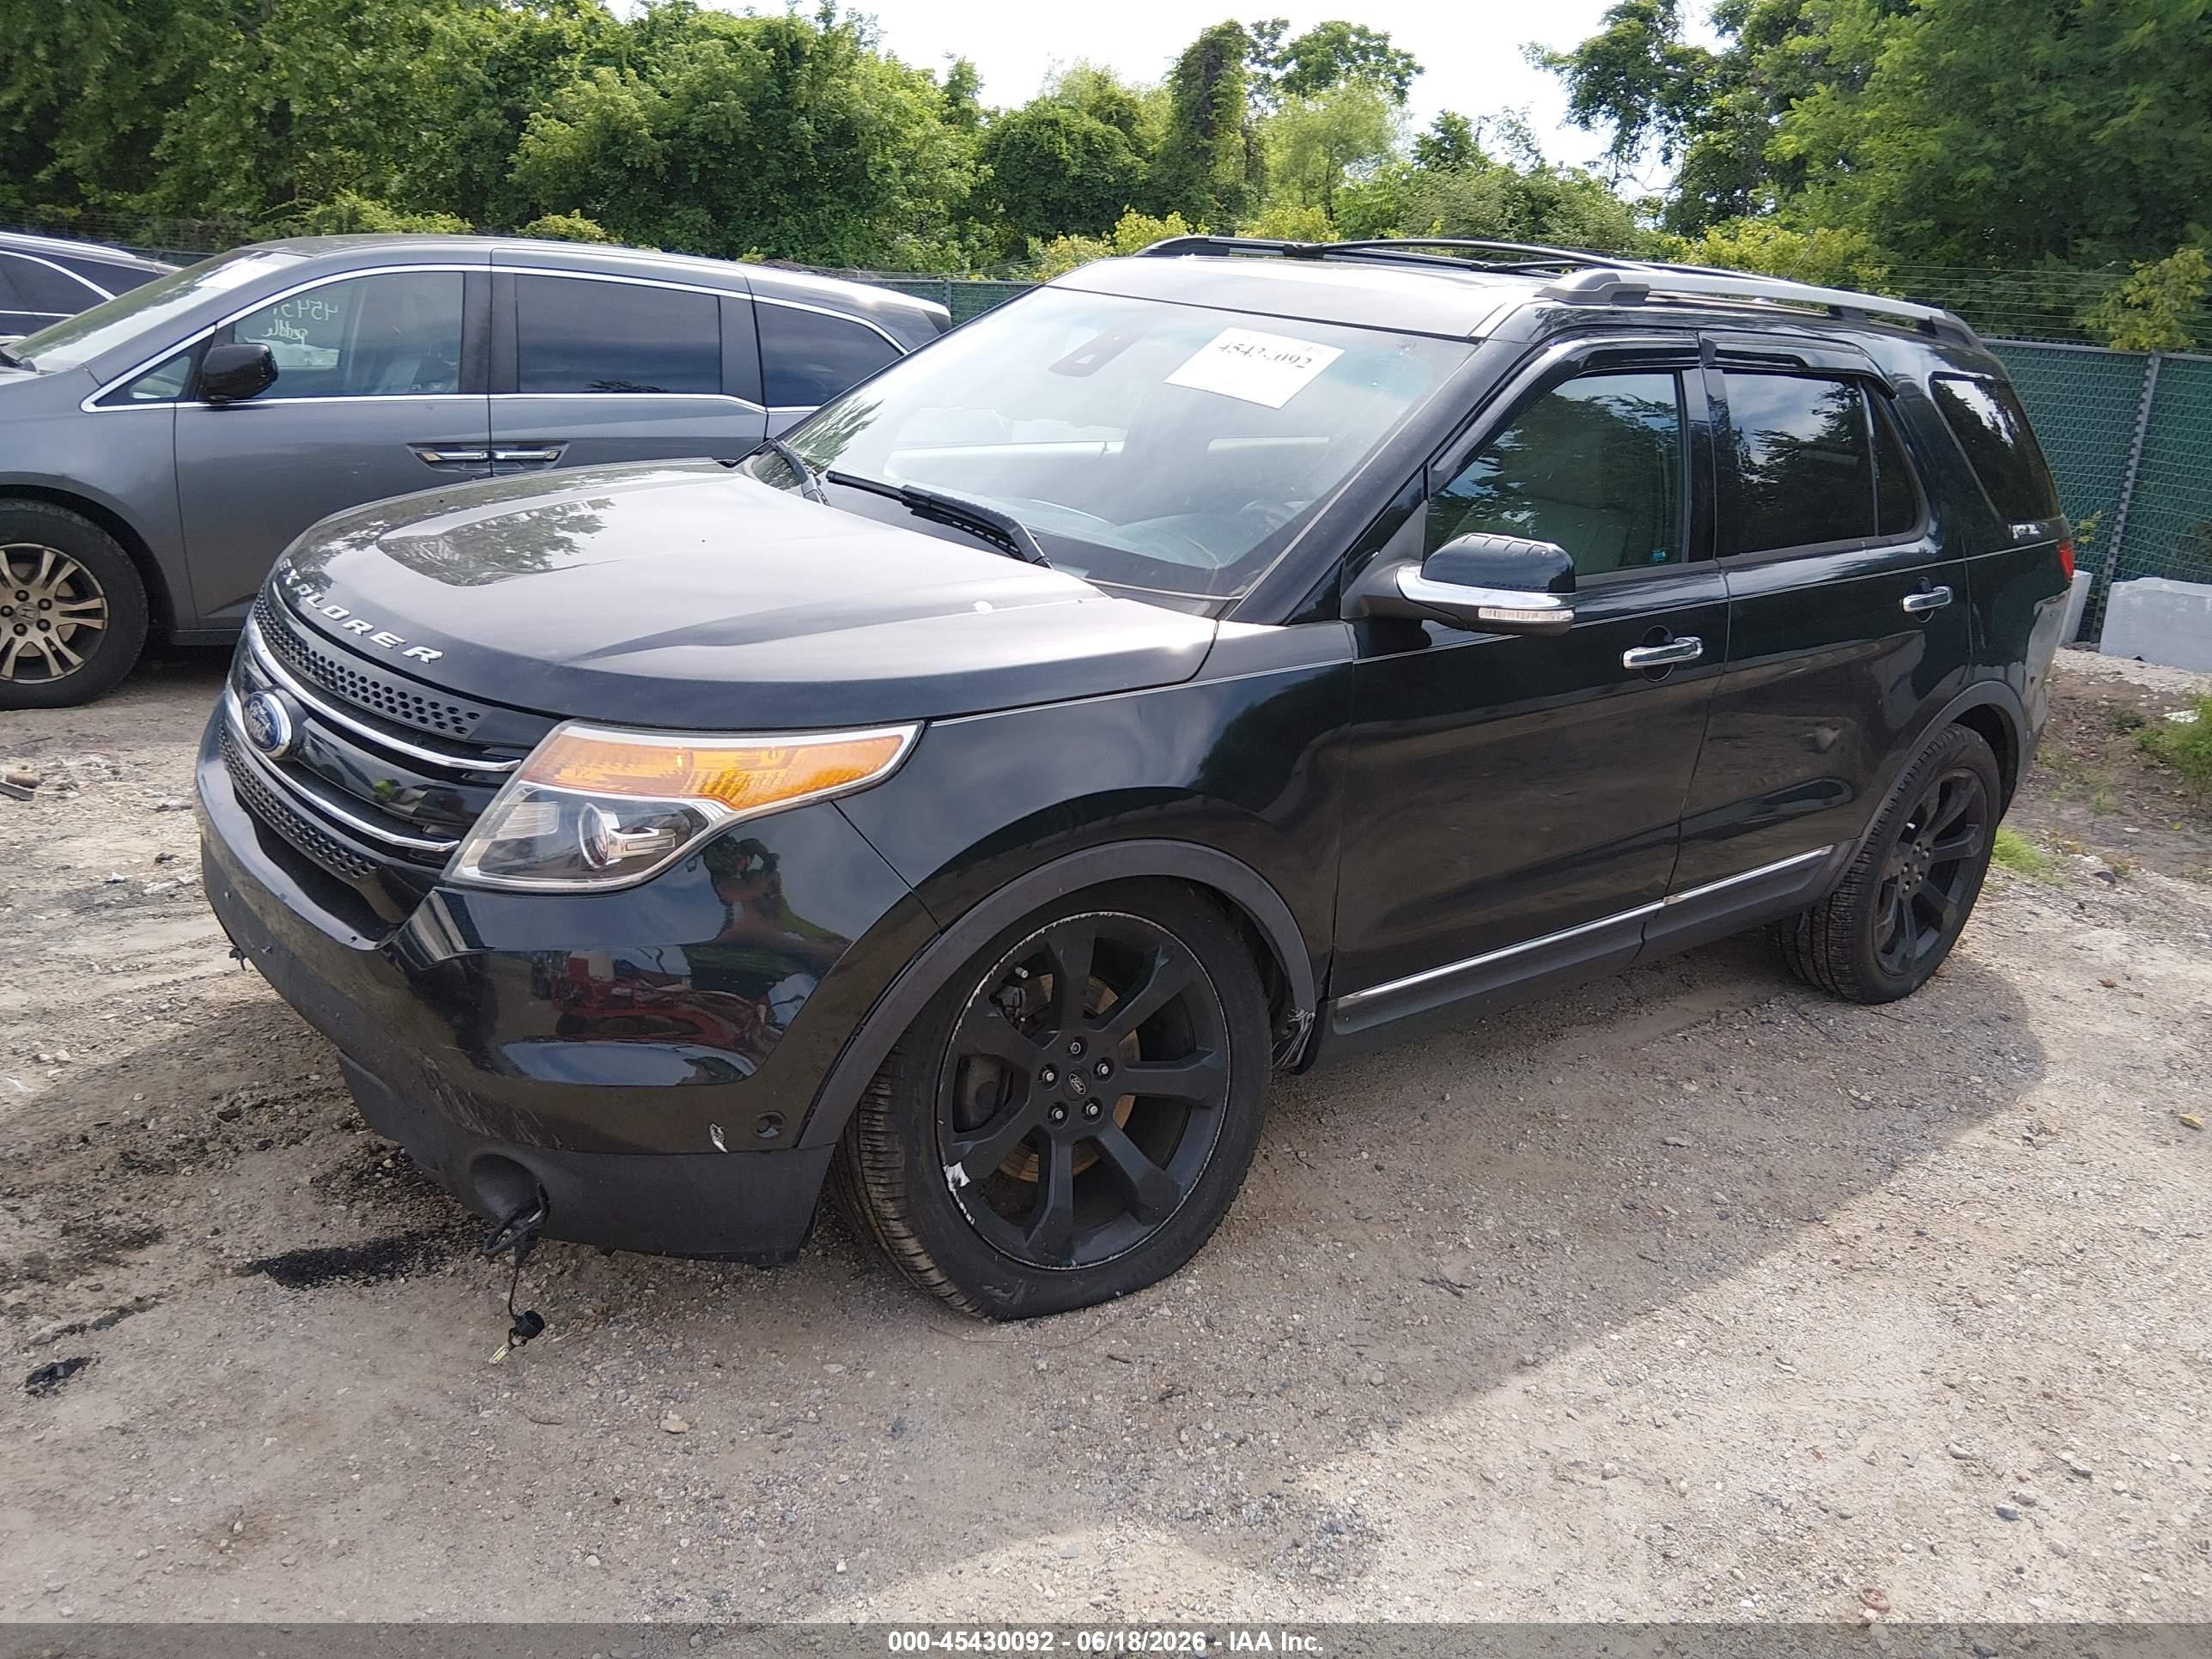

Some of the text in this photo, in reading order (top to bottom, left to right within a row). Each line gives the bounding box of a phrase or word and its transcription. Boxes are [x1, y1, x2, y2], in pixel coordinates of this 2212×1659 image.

[1218, 342, 1313, 370] 454092
[279, 557, 444, 665] EXPLORER
[246, 700, 272, 744] Ford
